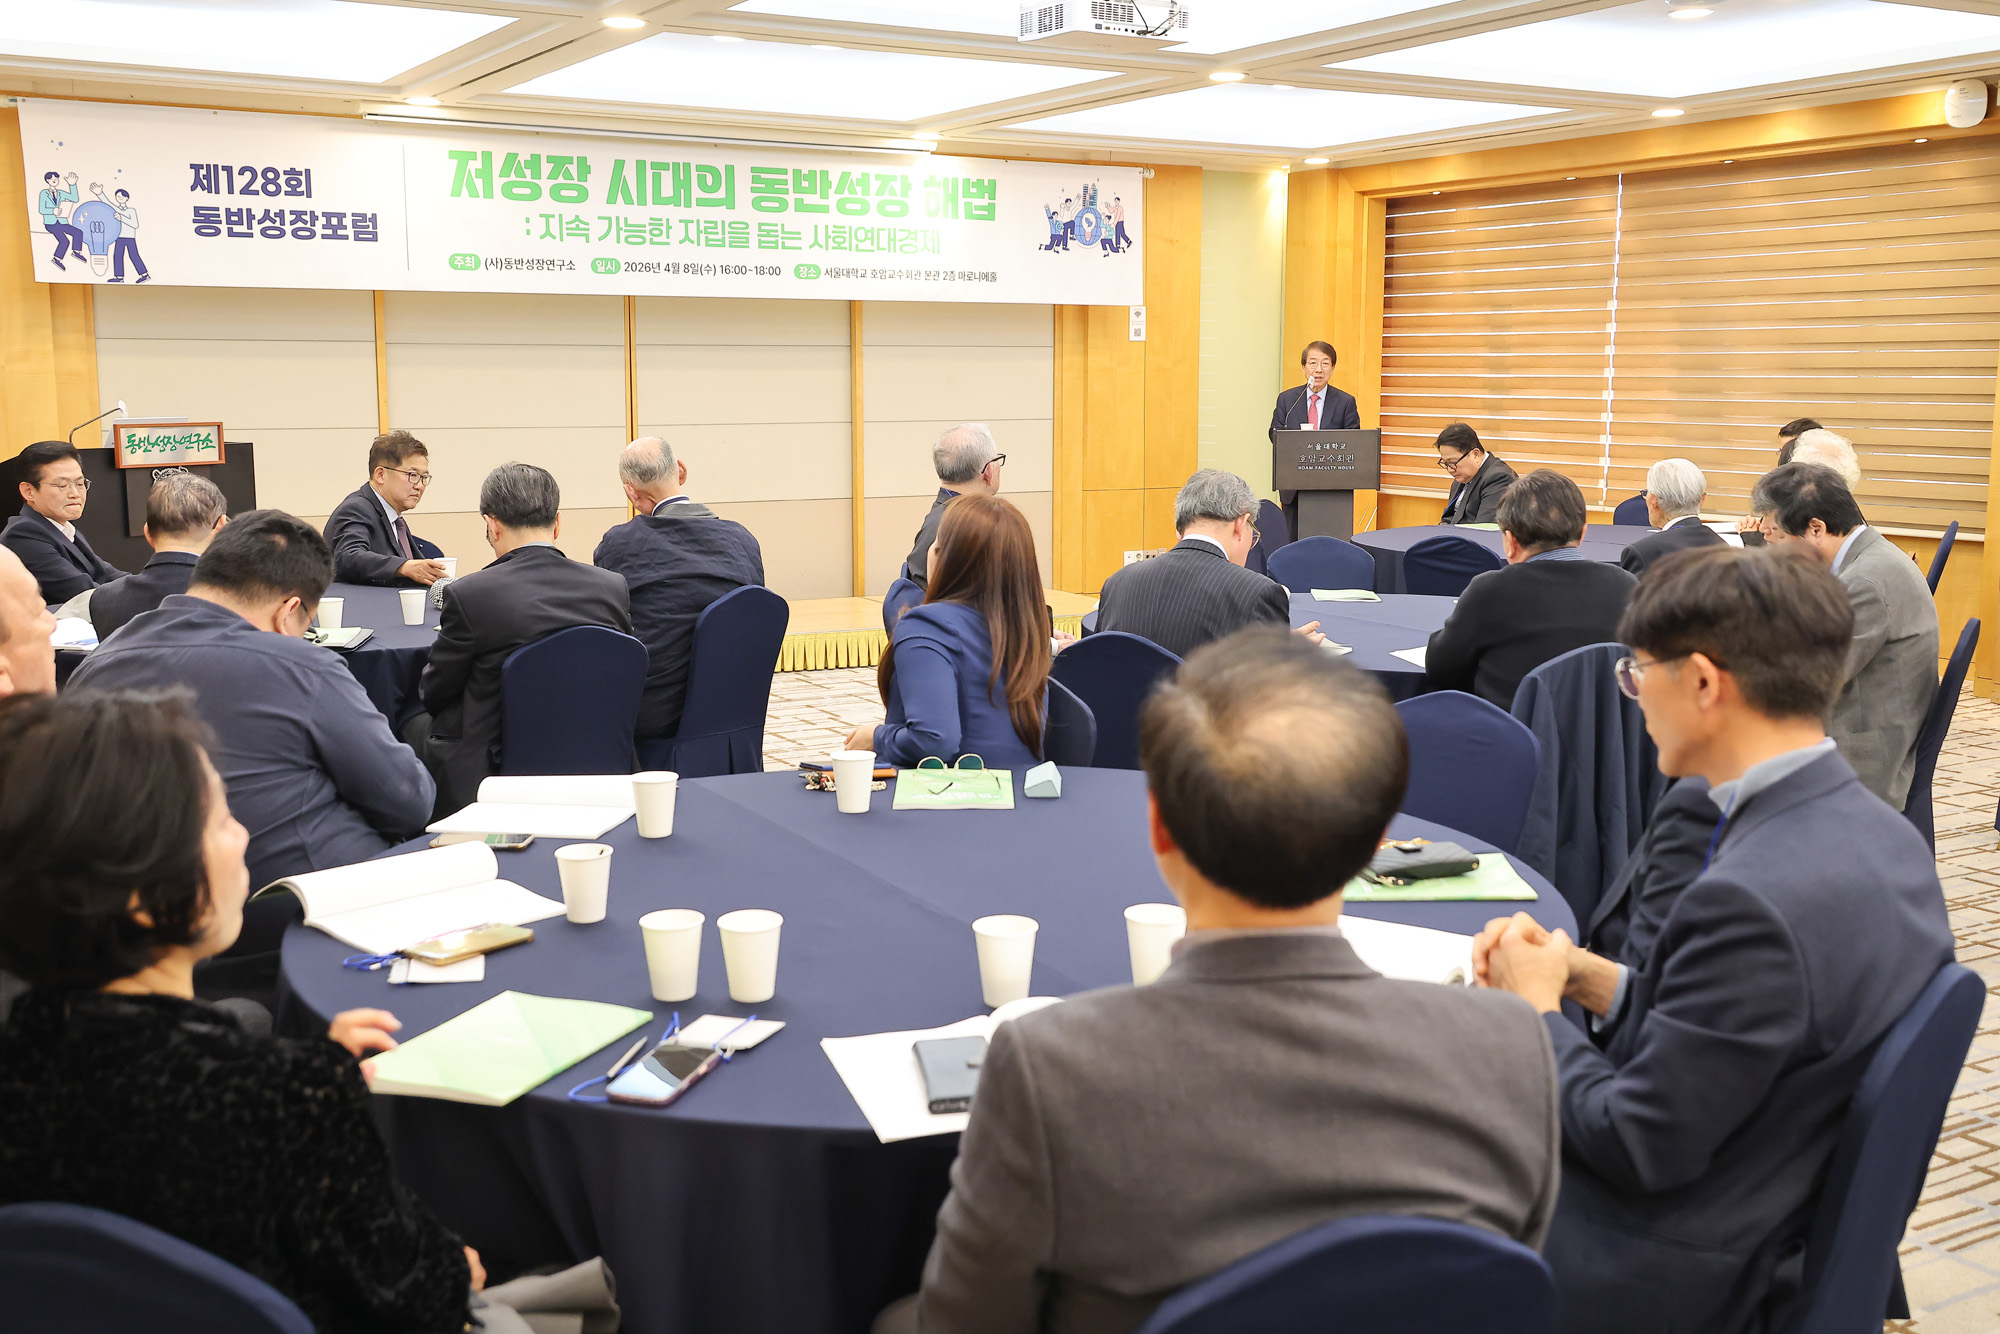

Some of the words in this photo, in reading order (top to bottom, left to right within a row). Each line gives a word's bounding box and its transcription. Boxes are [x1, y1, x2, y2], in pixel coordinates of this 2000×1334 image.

[189, 163, 312, 198] 제128회
[449, 150, 591, 203] 저성장
[606, 159, 735, 209] 시대의
[751, 166, 911, 217] 동반성장
[924, 175, 996, 221] 해법
[192, 206, 378, 242] 동반성장포럼
[539, 214, 590, 243] 지속
[598, 216, 672, 245] 가능한
[679, 219, 749, 248] 자립을
[757, 223, 802, 250] 돕는
[809, 224, 940, 254] 사회연대경제
[453, 256, 475, 269] 주최
[484, 257, 576, 271] (사)동반성장연구소
[595, 260, 617, 273] 일시
[624, 262, 661, 274] 2026년
[664, 262, 680, 275] 4월
[683, 263, 717, 276] 8일(수)
[719, 264, 782, 276] 16:00~18:00
[798, 266, 817, 278] 장소
[824, 267, 868, 279] 서울대학교
[870, 268, 921, 280] 호암교수회관
[925, 270, 940, 281] 본관
[943, 270, 956, 282] 2층
[958, 271, 998, 283] 마로니에홀
[125, 432, 216, 455] 동반성장연구소
[1298, 454, 1355, 463] 호암교수회관
[1306, 442, 1347, 450] 서울대학교
